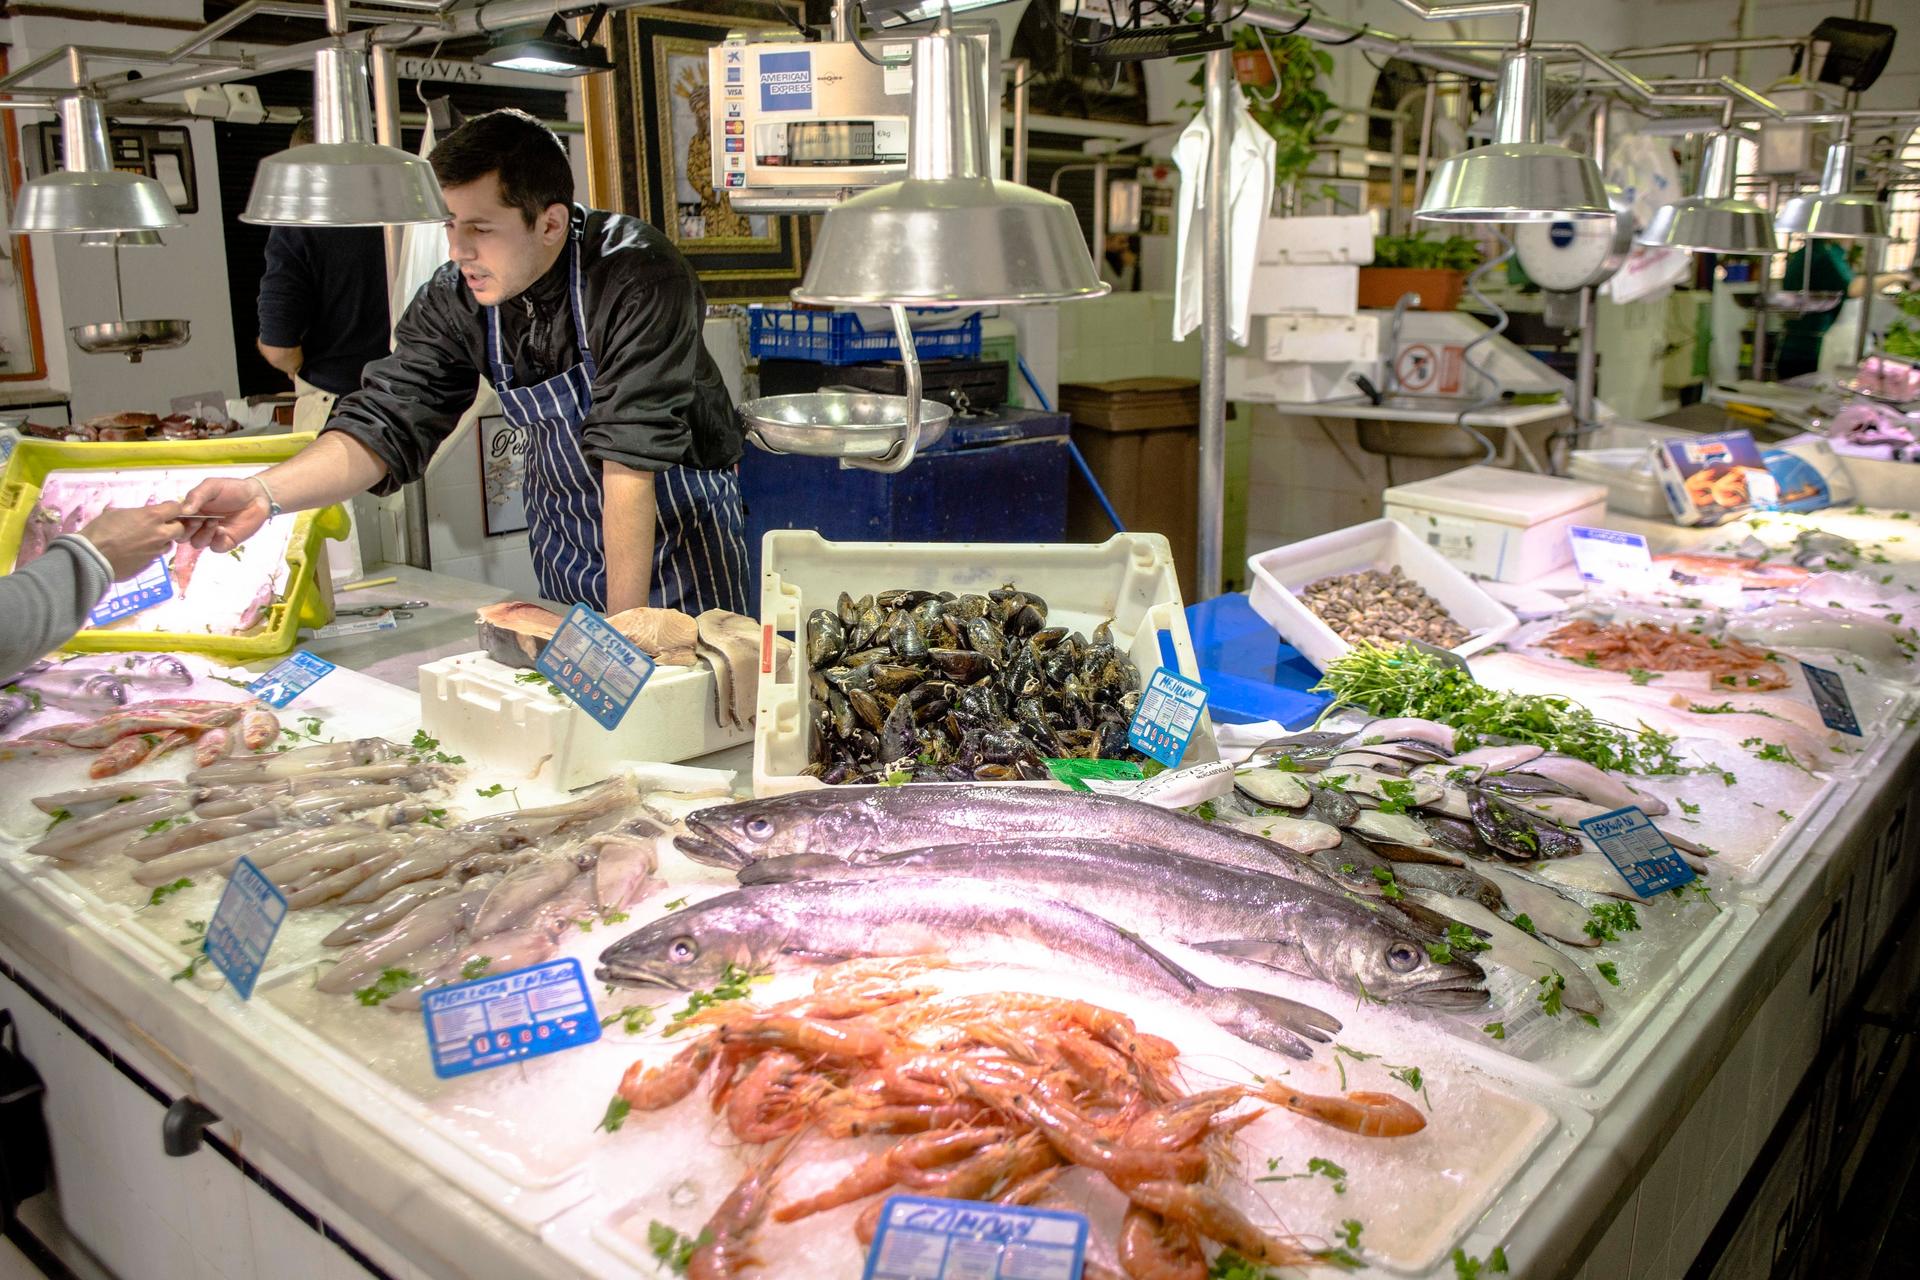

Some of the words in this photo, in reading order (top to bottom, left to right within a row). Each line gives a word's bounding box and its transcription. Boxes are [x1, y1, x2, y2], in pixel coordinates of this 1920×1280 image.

[760, 71, 809, 83] AMERICAN
[727, 88, 743, 96] VISA
[771, 84, 812, 95] EXPRESS
